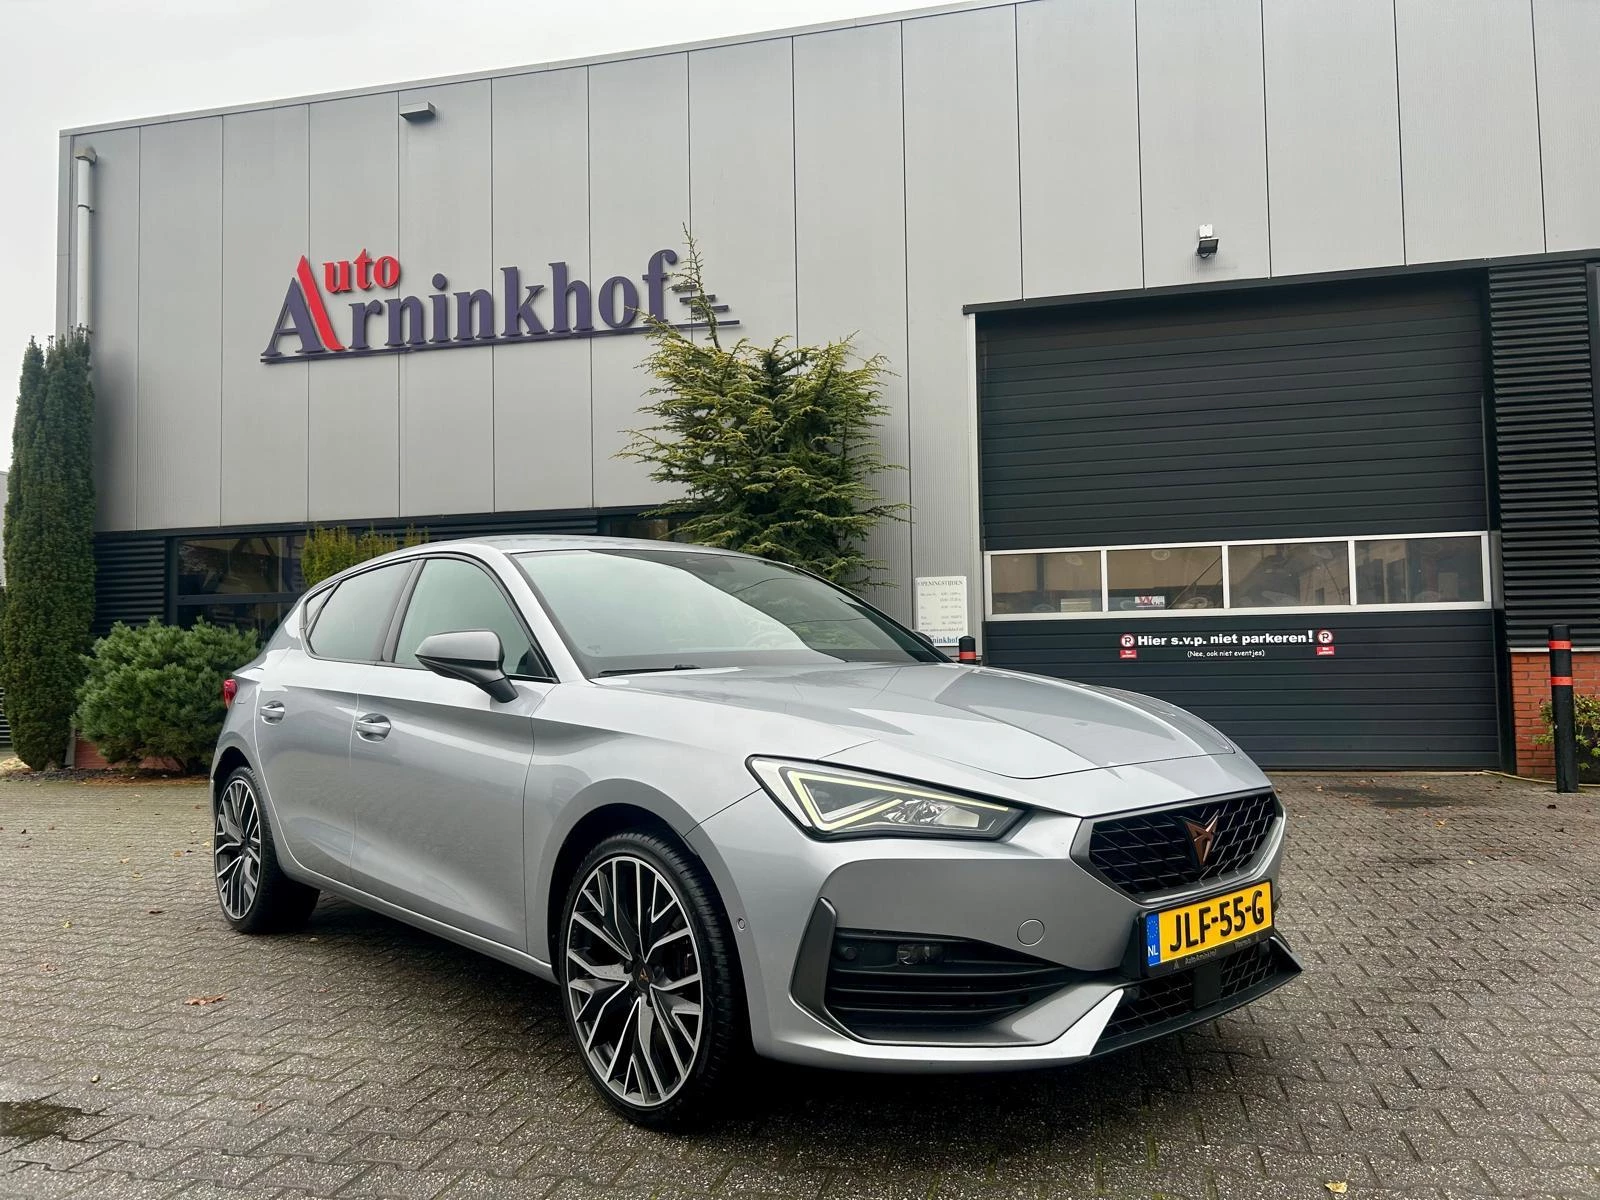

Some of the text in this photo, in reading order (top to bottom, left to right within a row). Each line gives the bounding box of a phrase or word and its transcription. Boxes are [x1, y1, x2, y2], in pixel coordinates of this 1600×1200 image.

[260, 249, 678, 357] Arninkhof
[1137, 630, 1314, 647] Hier s.v.p. niet parkeren!
[1187, 650, 1205, 658] (Nee,
[1234, 649, 1265, 658] eventjes)
[1169, 889, 1265, 952] JLF-55-G
[1147, 945, 1159, 957] NL
